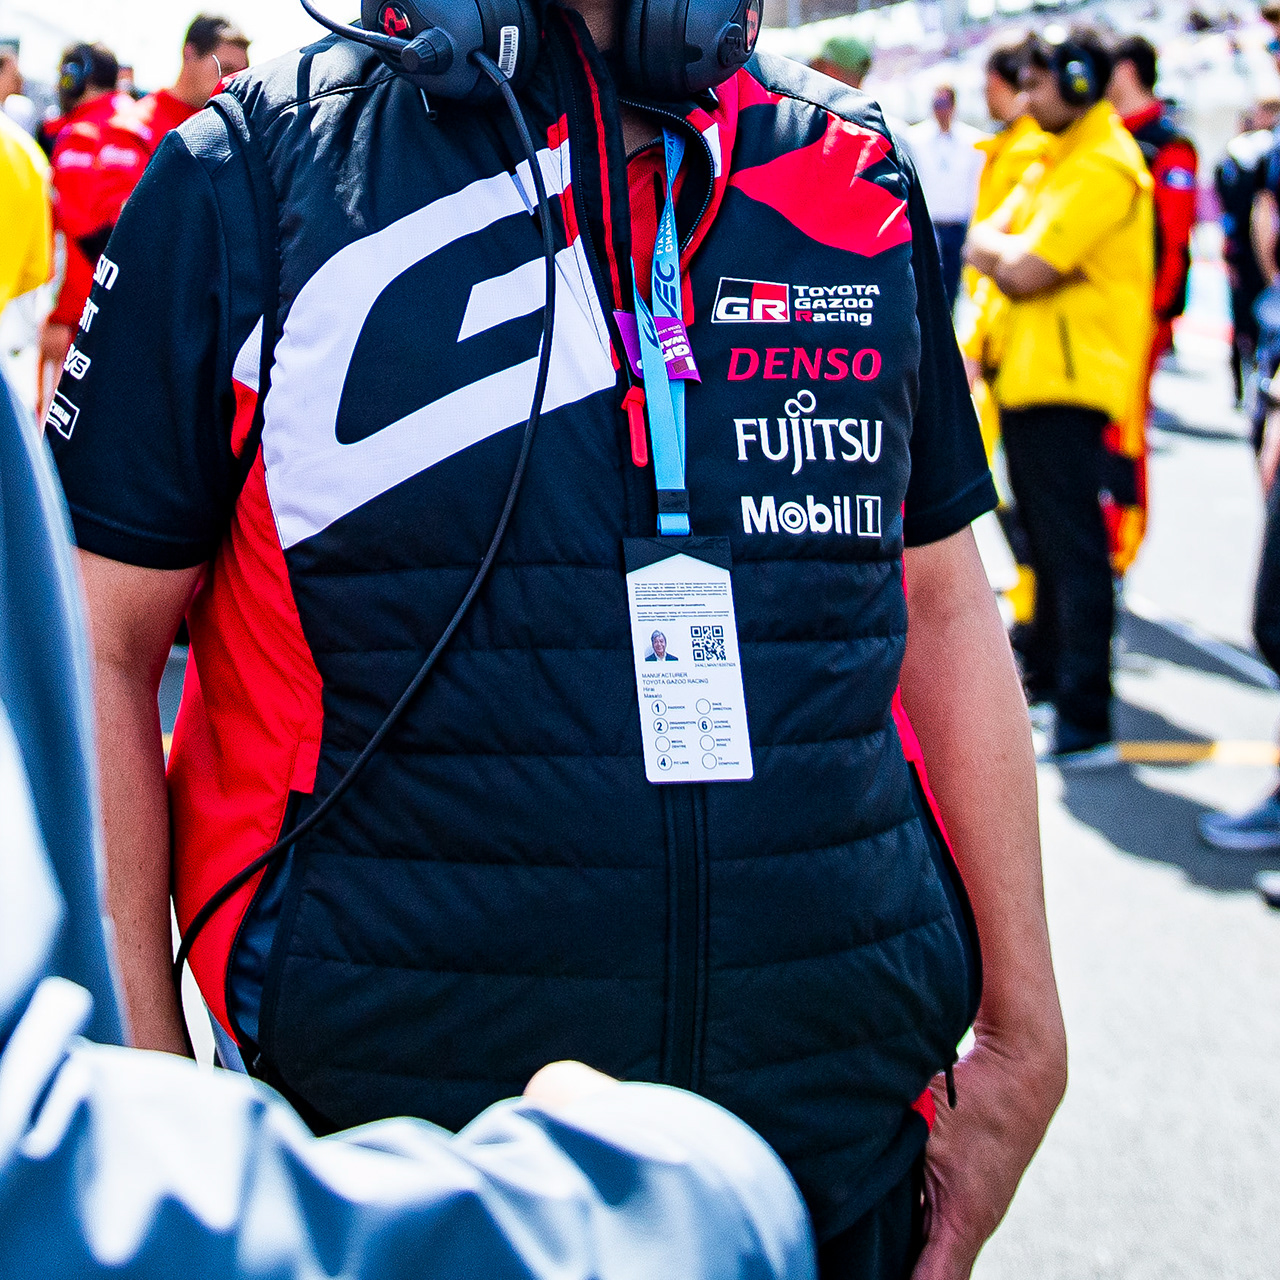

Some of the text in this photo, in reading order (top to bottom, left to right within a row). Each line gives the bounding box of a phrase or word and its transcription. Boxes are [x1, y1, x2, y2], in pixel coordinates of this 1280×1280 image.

[793, 285, 881, 297] TOYOTA
[716, 297, 787, 320] GR
[794, 297, 874, 309] GAZOO
[795, 310, 873, 326] Racing
[727, 347, 882, 381] DENSO
[733, 389, 883, 475] FUJITSU
[741, 495, 851, 534] Mobil
[655, 703, 660, 713] 1
[656, 722, 663, 731] 2
[701, 720, 708, 730] 6
[660, 757, 667, 767] 4
